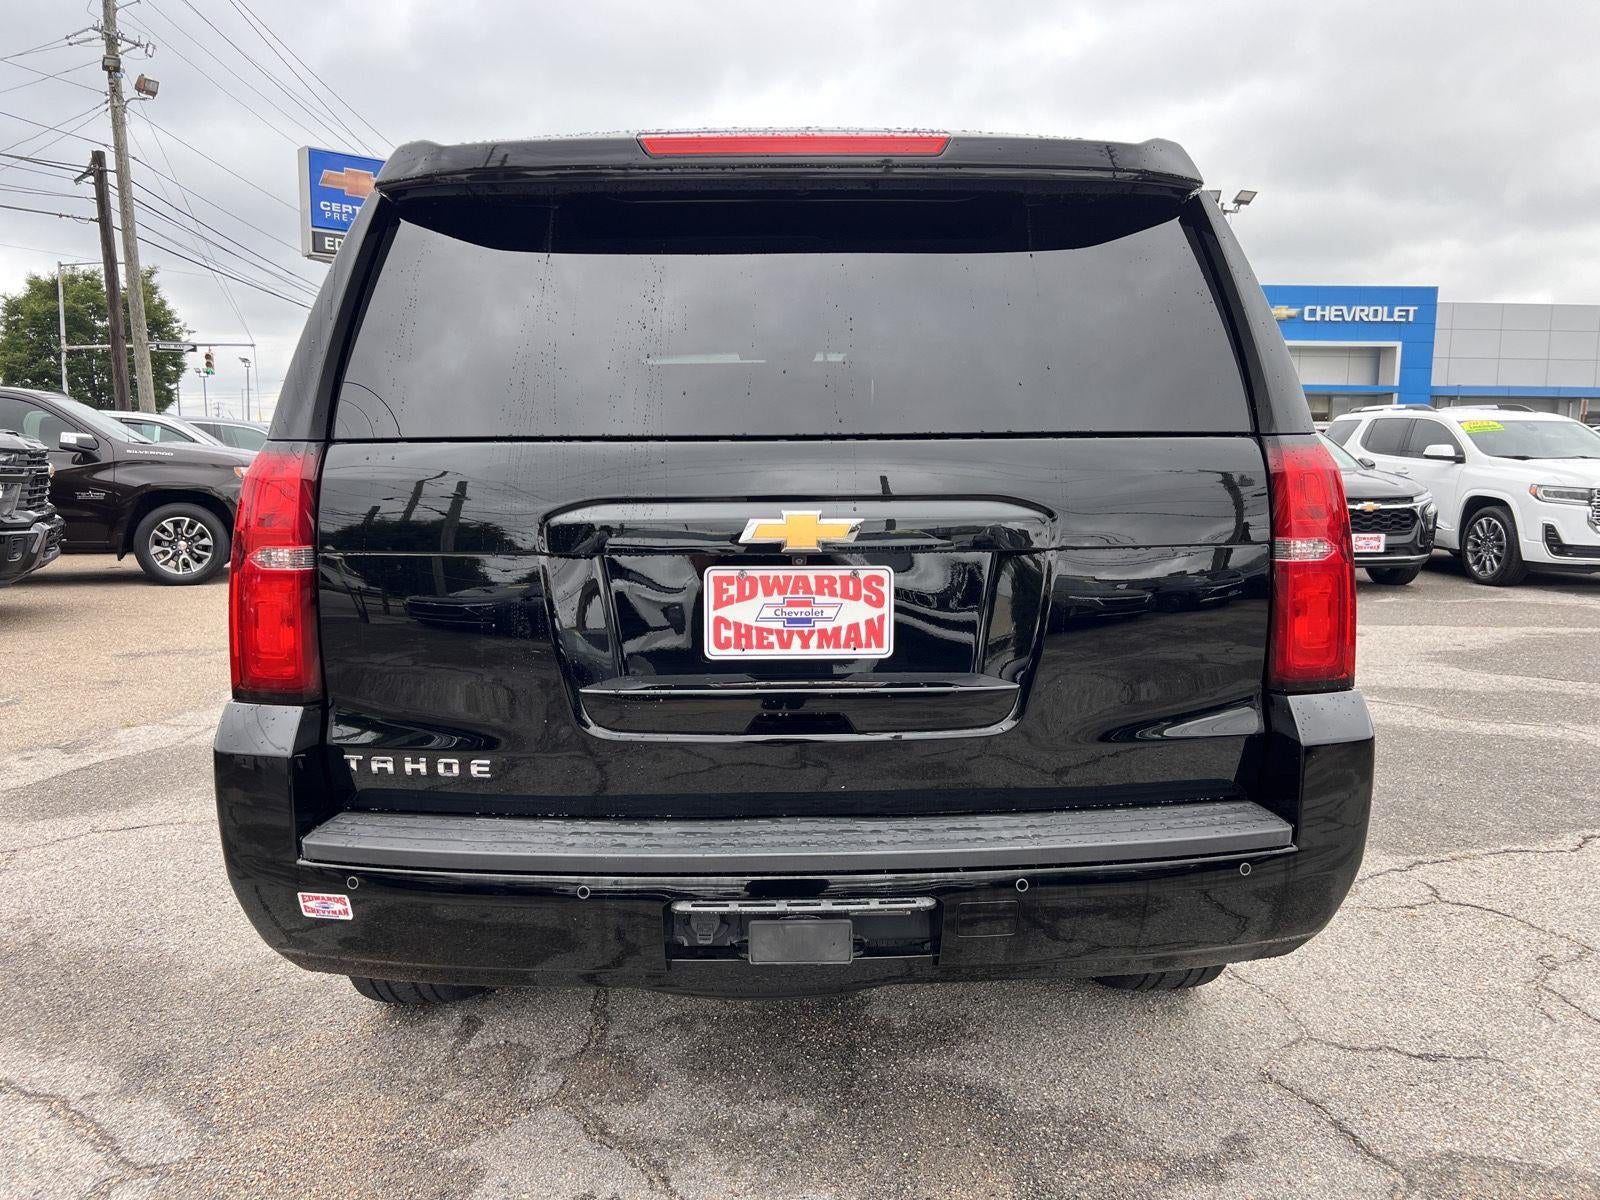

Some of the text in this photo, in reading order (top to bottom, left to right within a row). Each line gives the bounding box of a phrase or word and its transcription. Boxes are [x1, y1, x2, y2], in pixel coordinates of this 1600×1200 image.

[1303, 305, 1418, 322] CHEVROLET
[712, 574, 886, 611] EDWARDS
[773, 608, 824, 617] Chevrolet
[712, 613, 886, 650] CHEVYMAN
[343, 754, 492, 778] TAHOE
[301, 894, 347, 906] EDWARDS
[303, 905, 349, 916] CHEVYMAN
